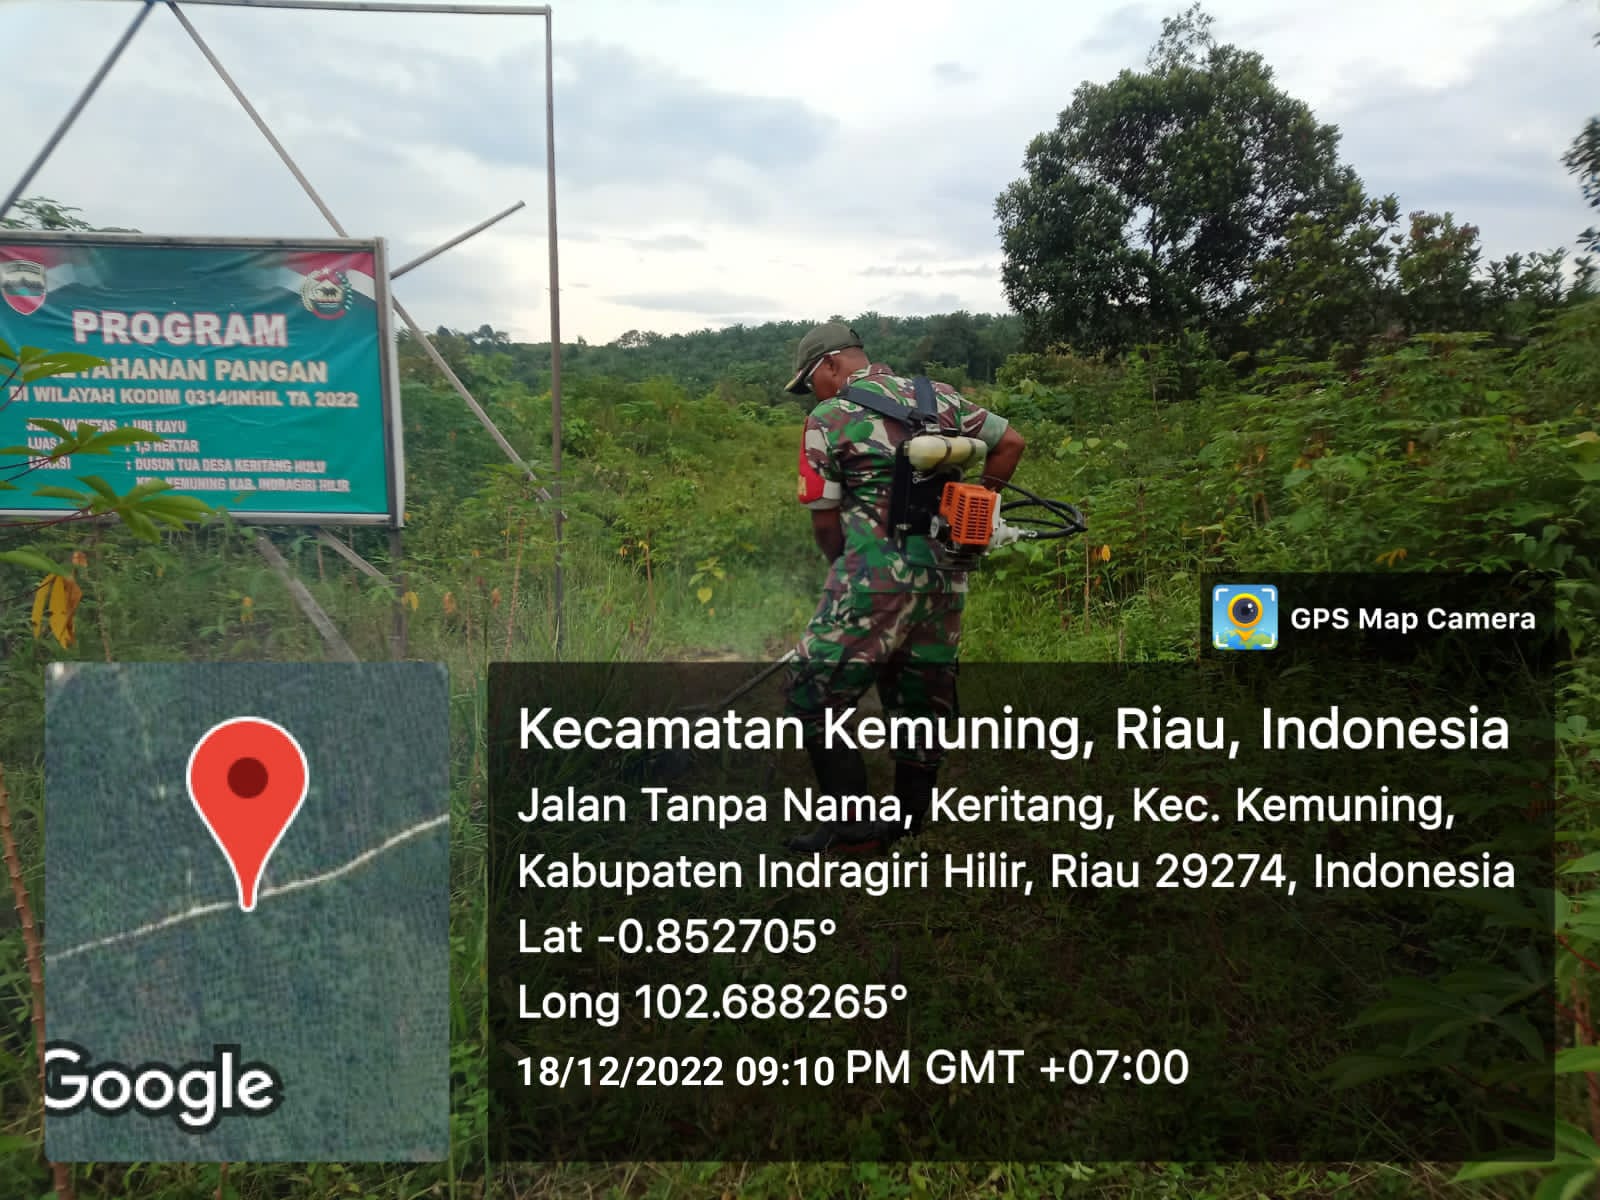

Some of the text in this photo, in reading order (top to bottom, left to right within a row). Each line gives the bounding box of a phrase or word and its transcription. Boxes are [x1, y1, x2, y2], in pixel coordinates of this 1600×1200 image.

[72, 310, 288, 347] PROGRAM
[214, 360, 328, 383] PANGAN
[33, 386, 116, 404] WILAYAH
[120, 387, 181, 405] KODIM
[288, 391, 311, 407] TA
[314, 391, 359, 408] 2022
[155, 419, 188, 434] KAYU
[27, 436, 57, 451] LUAS
[177, 458, 200, 472] TUA
[201, 459, 232, 473] DESA
